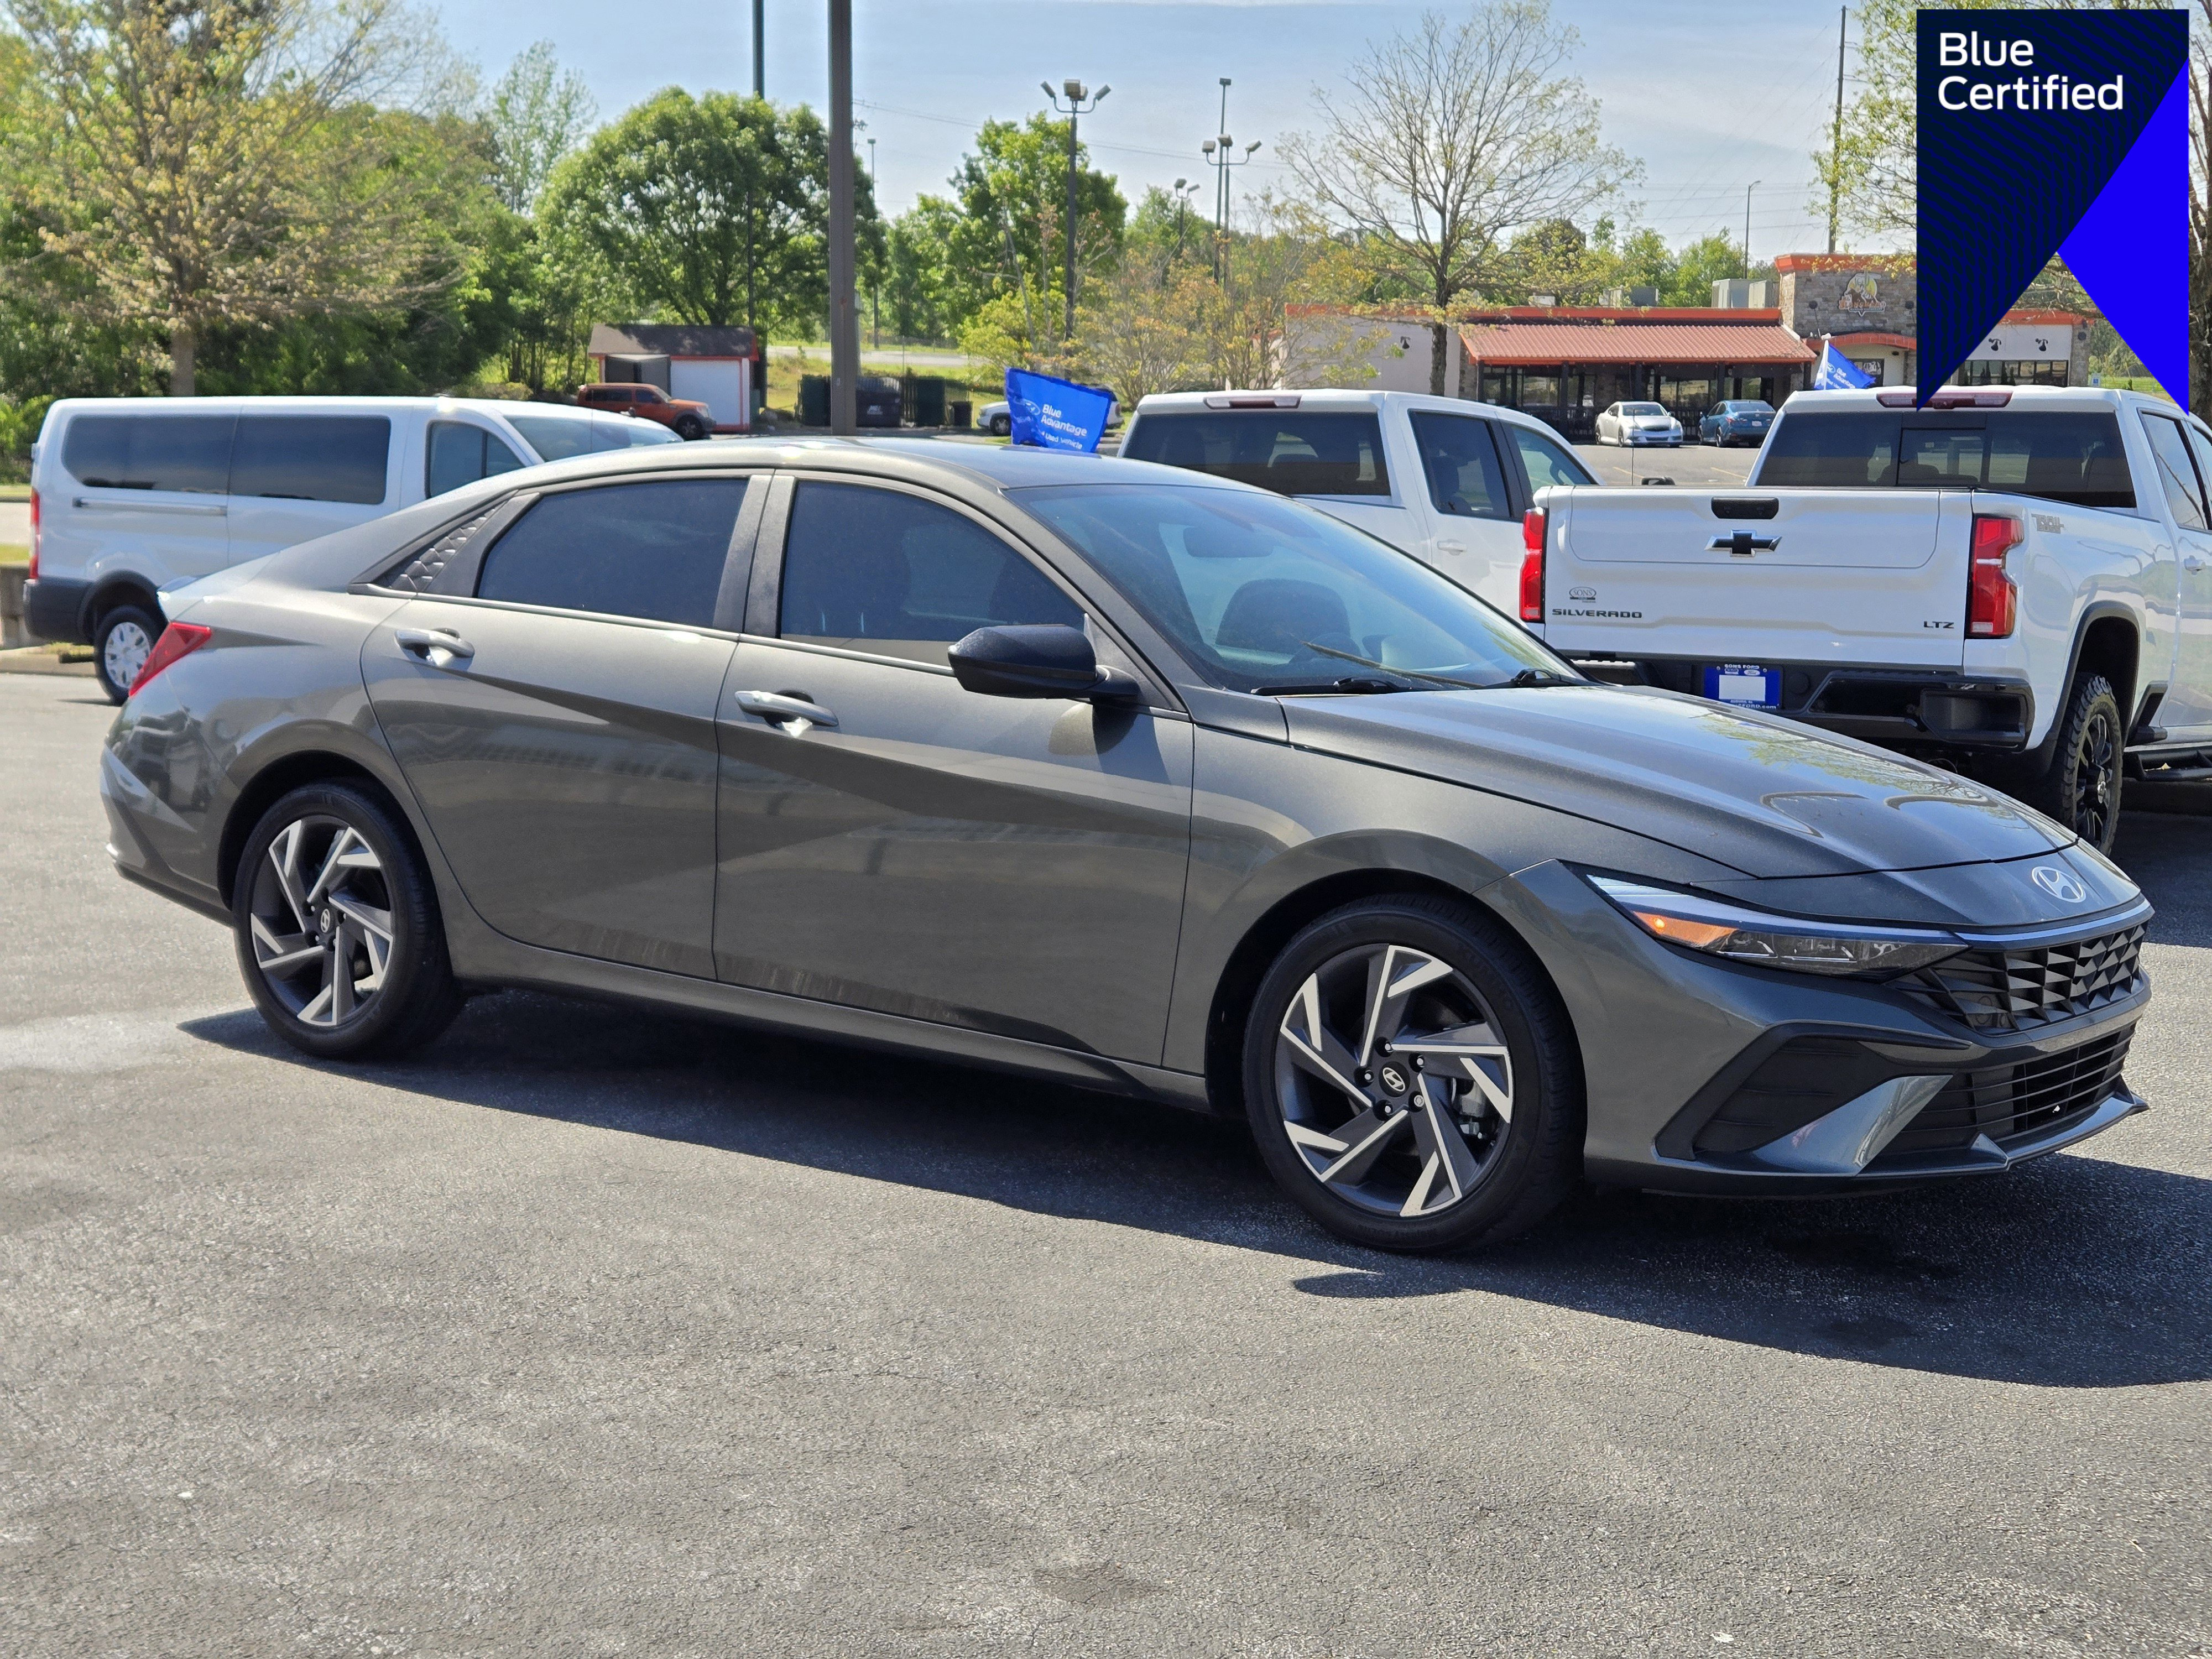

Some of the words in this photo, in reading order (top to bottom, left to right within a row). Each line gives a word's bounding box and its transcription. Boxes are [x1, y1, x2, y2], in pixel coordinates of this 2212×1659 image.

[1042, 404, 1062, 418] Blue
[1041, 414, 1088, 437] Advantage
[1552, 608, 1642, 619] SILVERADO
